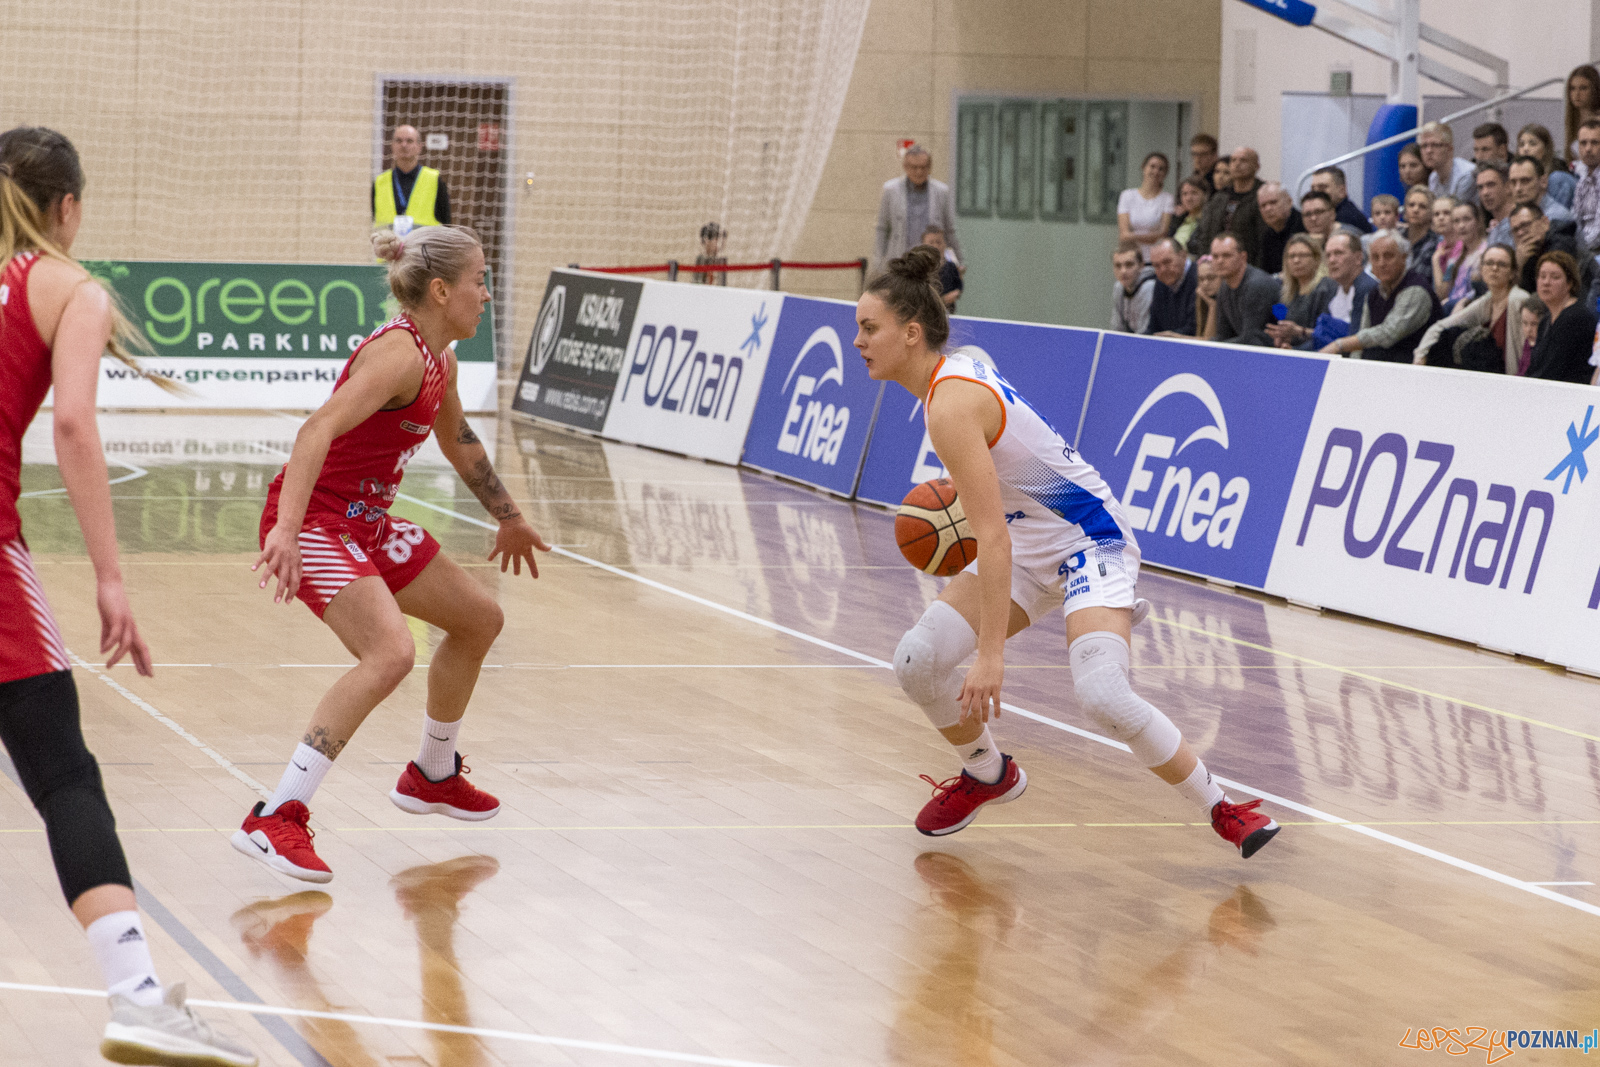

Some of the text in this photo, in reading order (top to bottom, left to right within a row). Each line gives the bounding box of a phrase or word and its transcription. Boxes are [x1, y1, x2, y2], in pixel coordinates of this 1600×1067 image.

[144, 276, 366, 346] green
[197, 332, 365, 352] PARKING
[106, 367, 341, 383] www.greenparki
[776, 374, 850, 466] Enea
[1122, 432, 1250, 550] Enea
